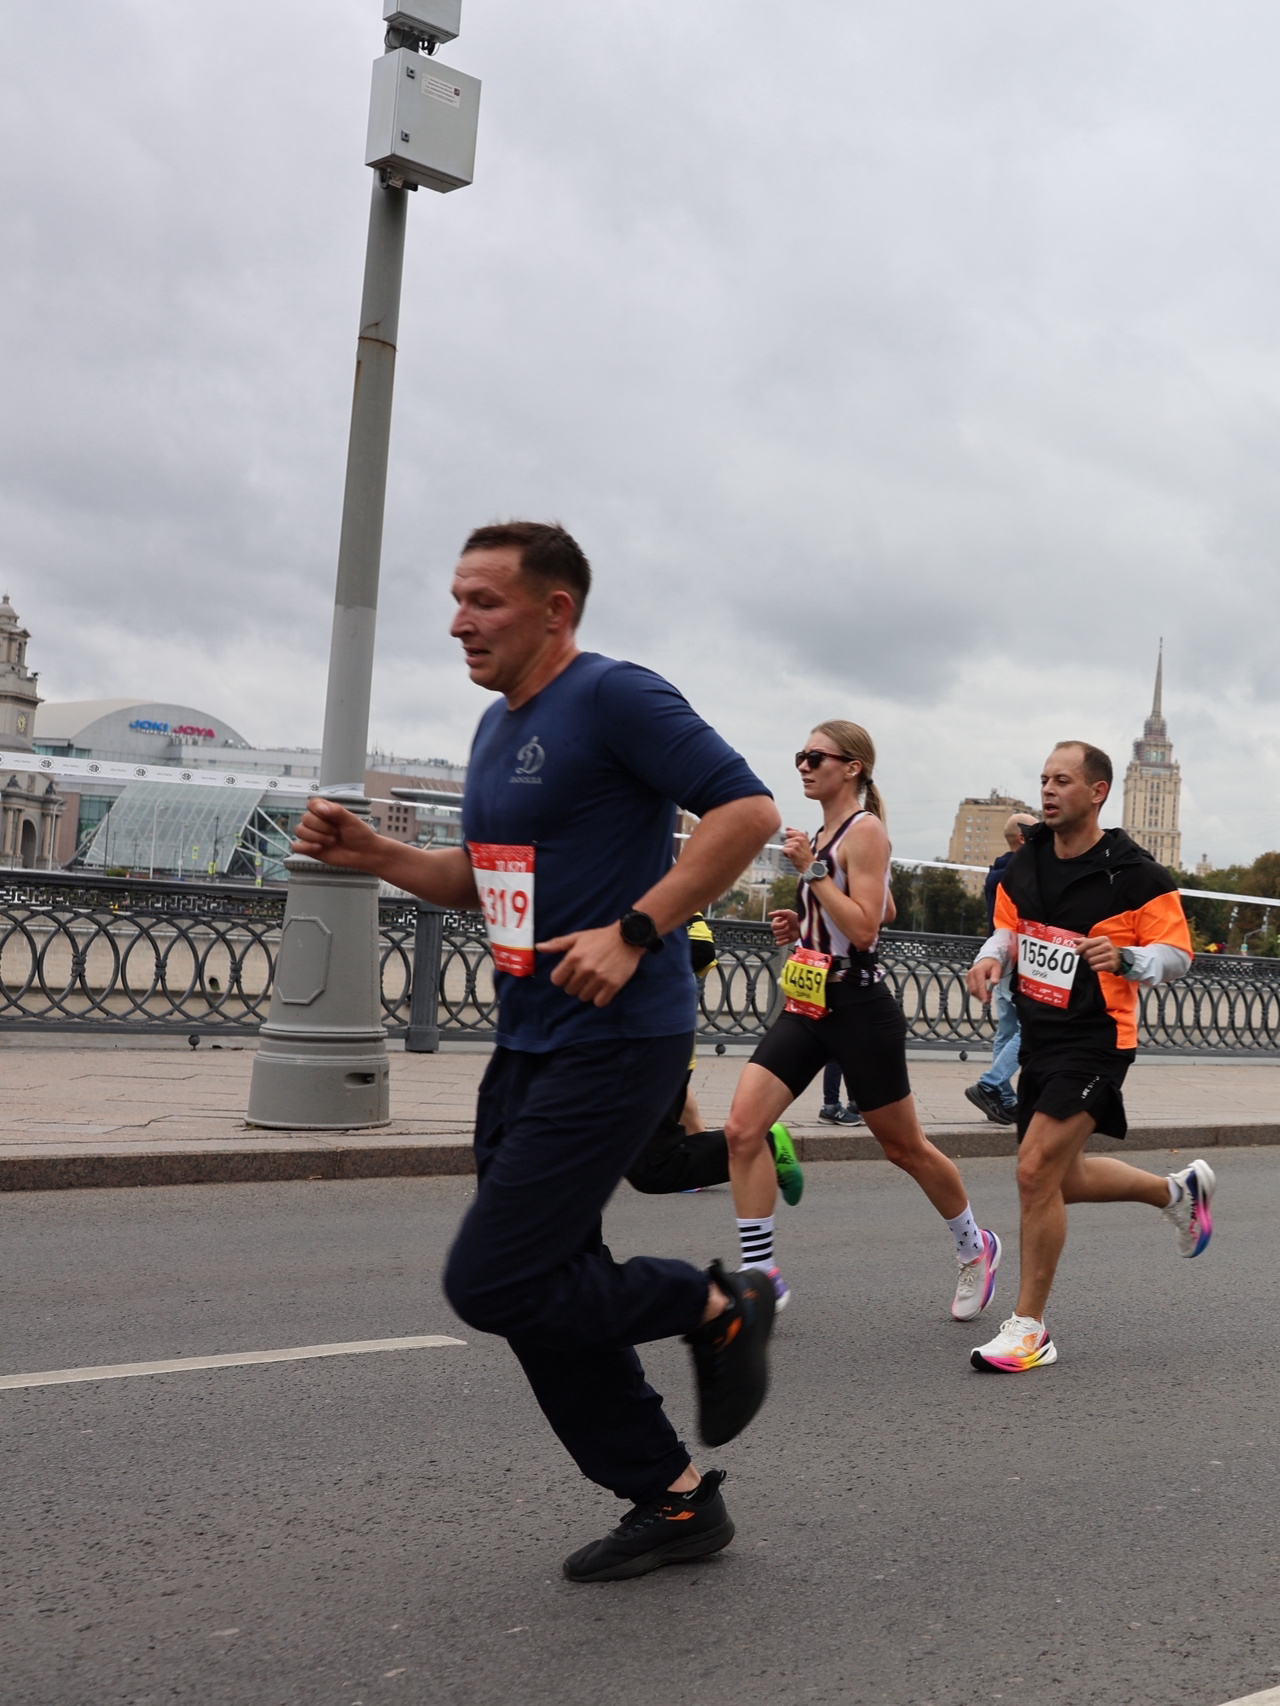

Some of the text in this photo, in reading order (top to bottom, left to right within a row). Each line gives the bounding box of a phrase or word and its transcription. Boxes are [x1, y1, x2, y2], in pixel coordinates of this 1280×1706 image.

[129, 720, 168, 733] JOKI
[173, 725, 215, 739] JOYA
[1052, 936, 1062, 945] 10
[1021, 939, 1075, 975] 15560
[784, 963, 823, 994] 14659
